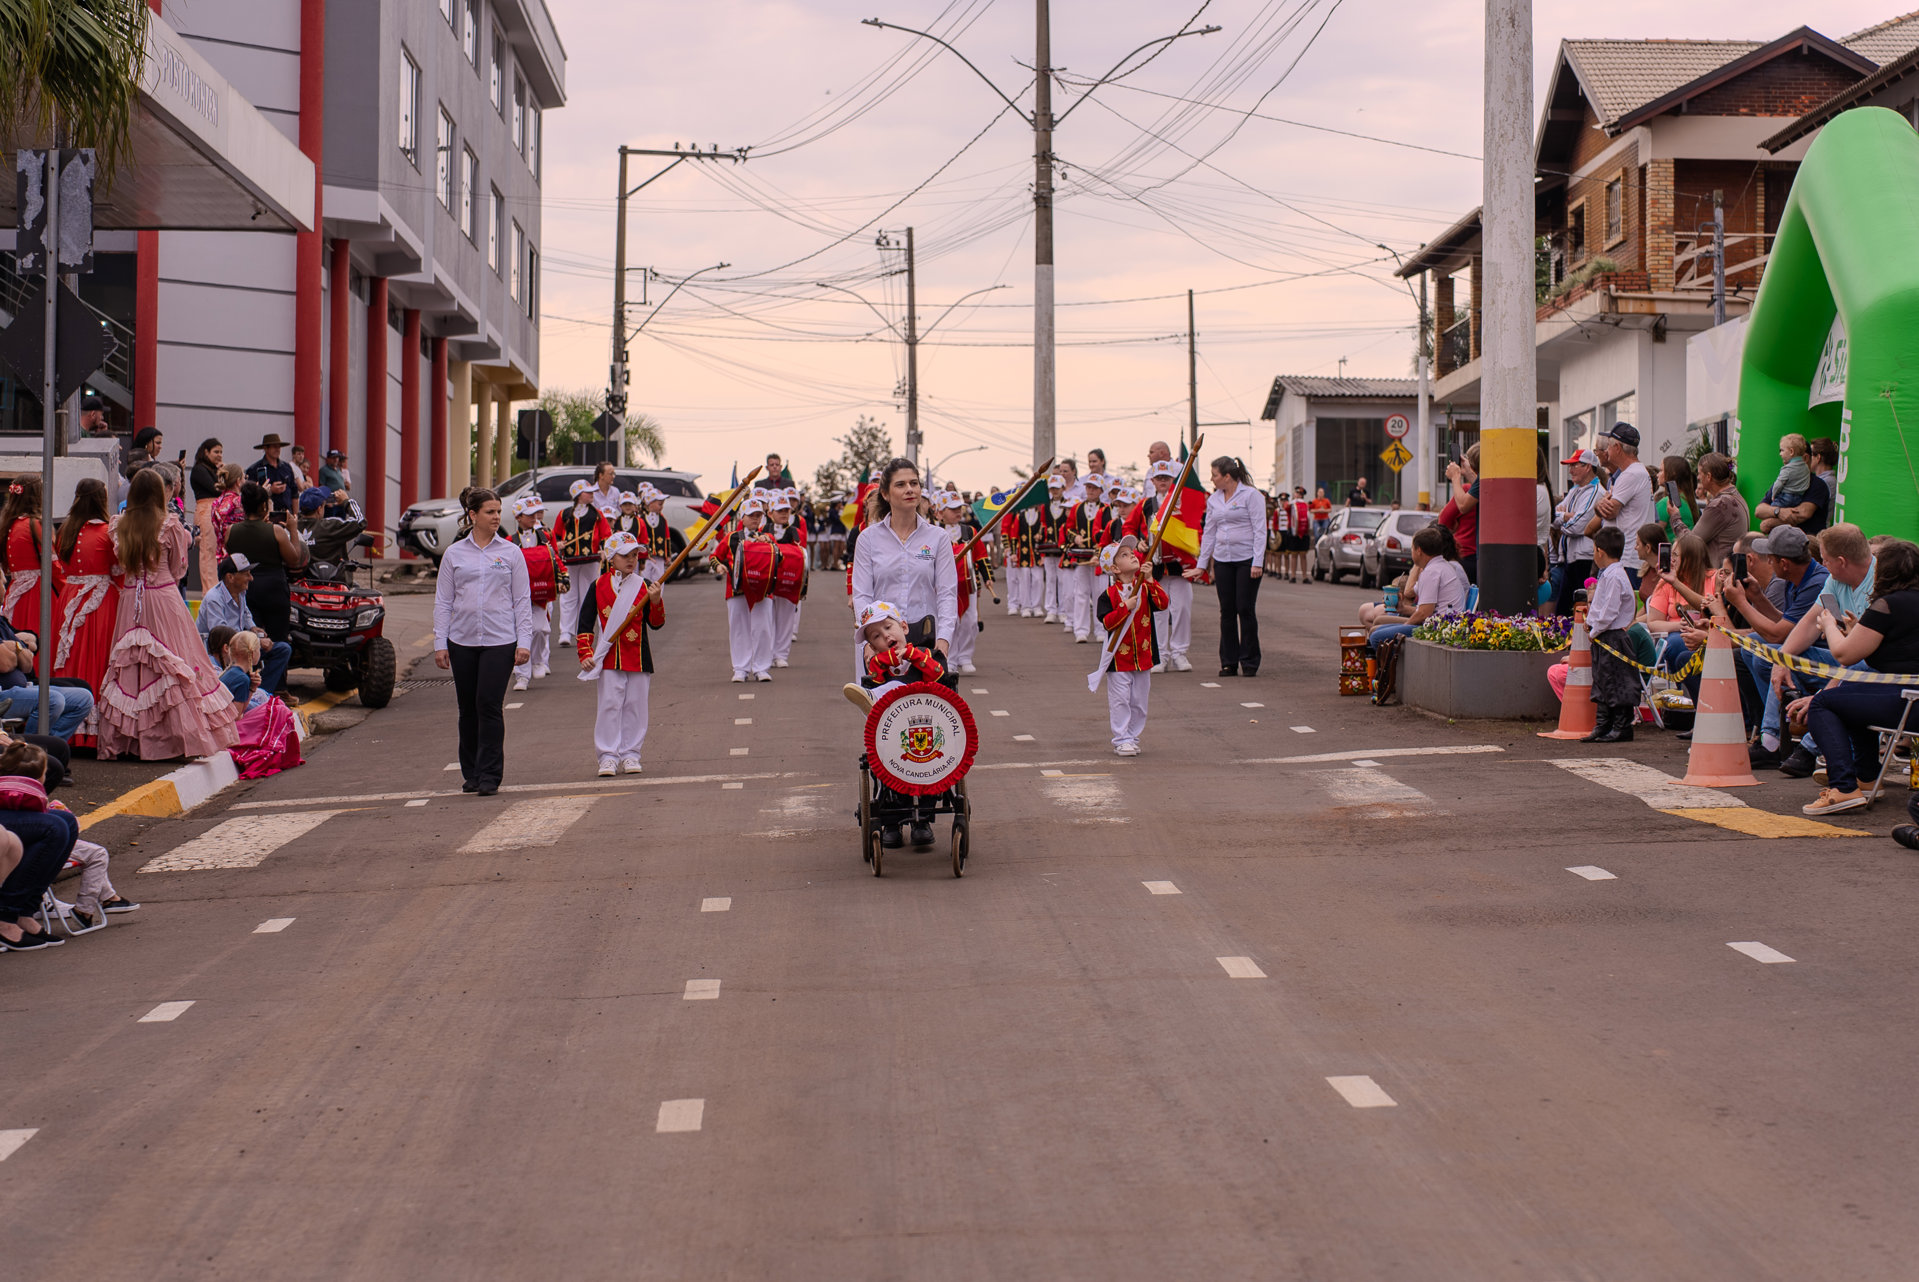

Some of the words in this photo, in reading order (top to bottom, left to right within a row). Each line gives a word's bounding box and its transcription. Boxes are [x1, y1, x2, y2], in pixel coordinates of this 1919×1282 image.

[163, 45, 190, 102] POSTO
[190, 70, 219, 129] KONZEN
[1391, 419, 1404, 429] 20
[1660, 439, 1672, 453] 221
[881, 698, 923, 741] PREFEITURA
[925, 698, 961, 737] MUNICIPAL
[888, 758, 905, 774] NOVA
[905, 755, 956, 778] CANDELÁRIA-RS
